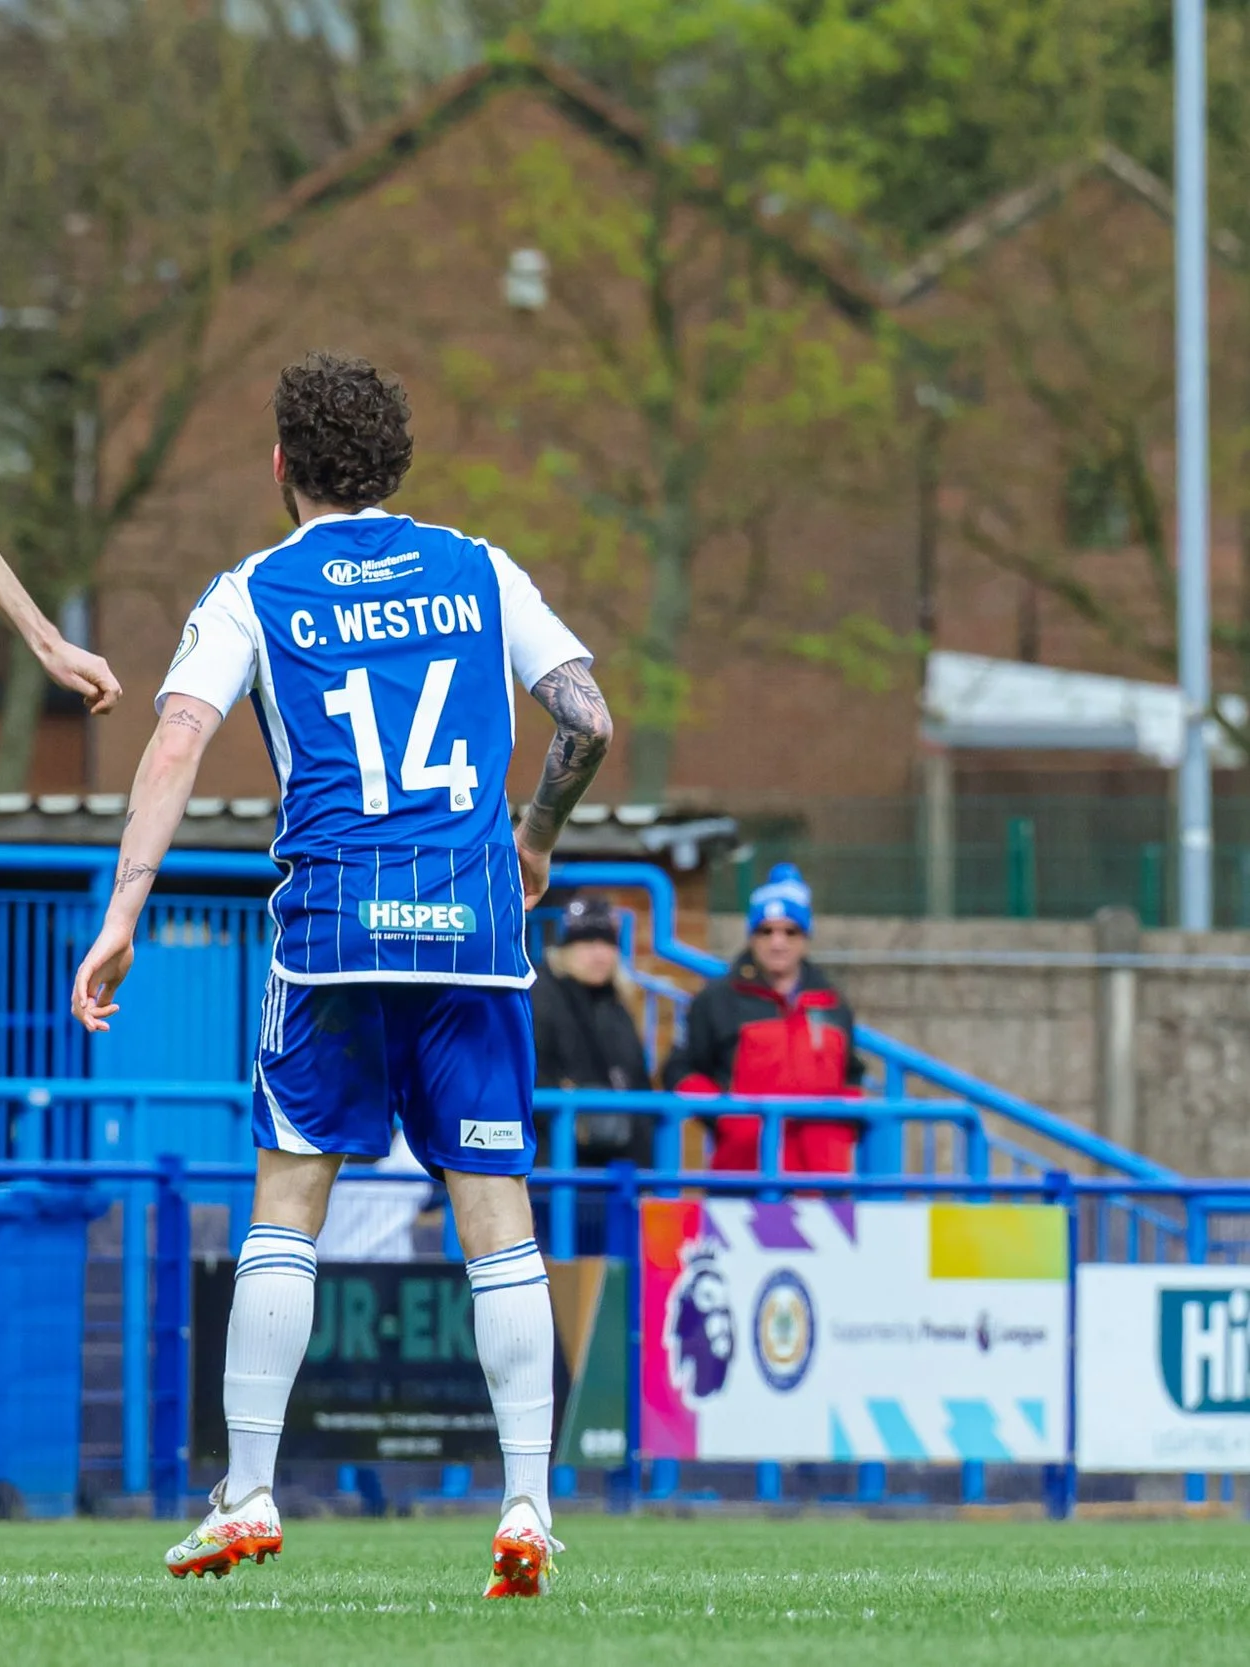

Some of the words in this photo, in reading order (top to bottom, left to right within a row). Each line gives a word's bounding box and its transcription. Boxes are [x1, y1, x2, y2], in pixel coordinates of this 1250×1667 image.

[361, 551, 420, 571] Minuteman
[290, 609, 328, 649] C.
[333, 594, 483, 644] WESTON
[323, 658, 479, 816] 14
[383, 933, 404, 941] SAFETY
[1181, 1289, 1250, 1412] Hi
